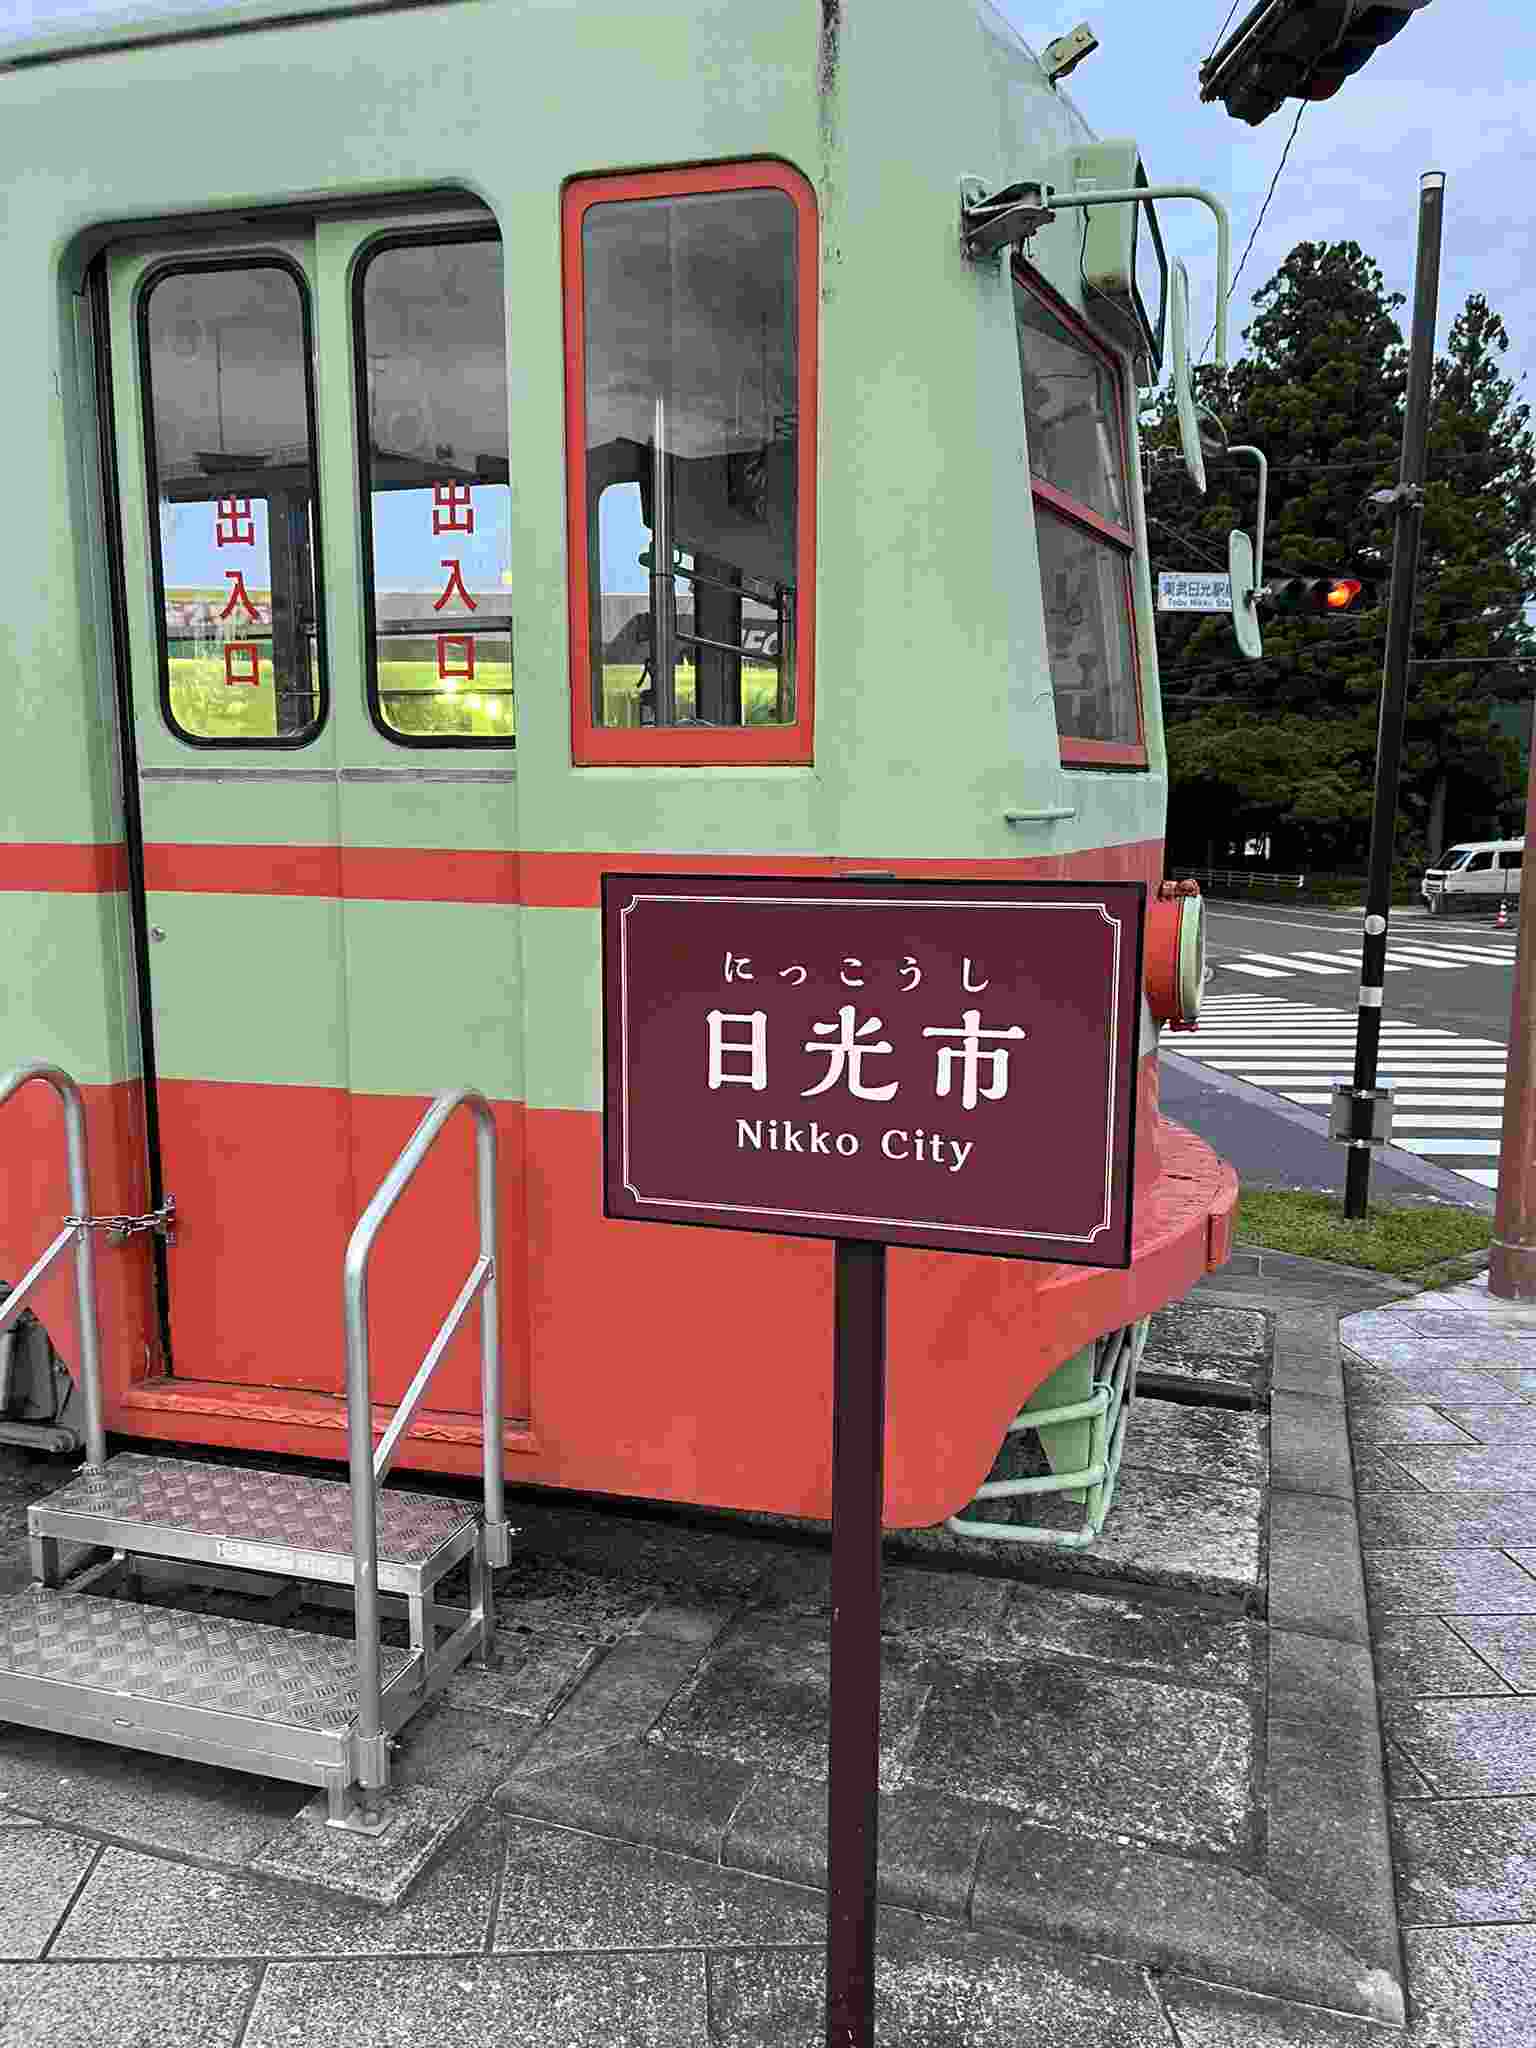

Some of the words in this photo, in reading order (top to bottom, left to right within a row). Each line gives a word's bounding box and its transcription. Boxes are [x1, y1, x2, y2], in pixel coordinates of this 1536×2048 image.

[216, 496, 261, 688] 出入口
[432, 480, 477, 681] 出入口
[724, 951, 990, 993] にっこうし
[705, 1004, 1027, 1111] 日光市
[735, 1119, 860, 1157] Nikko
[880, 1129, 974, 1172] City
